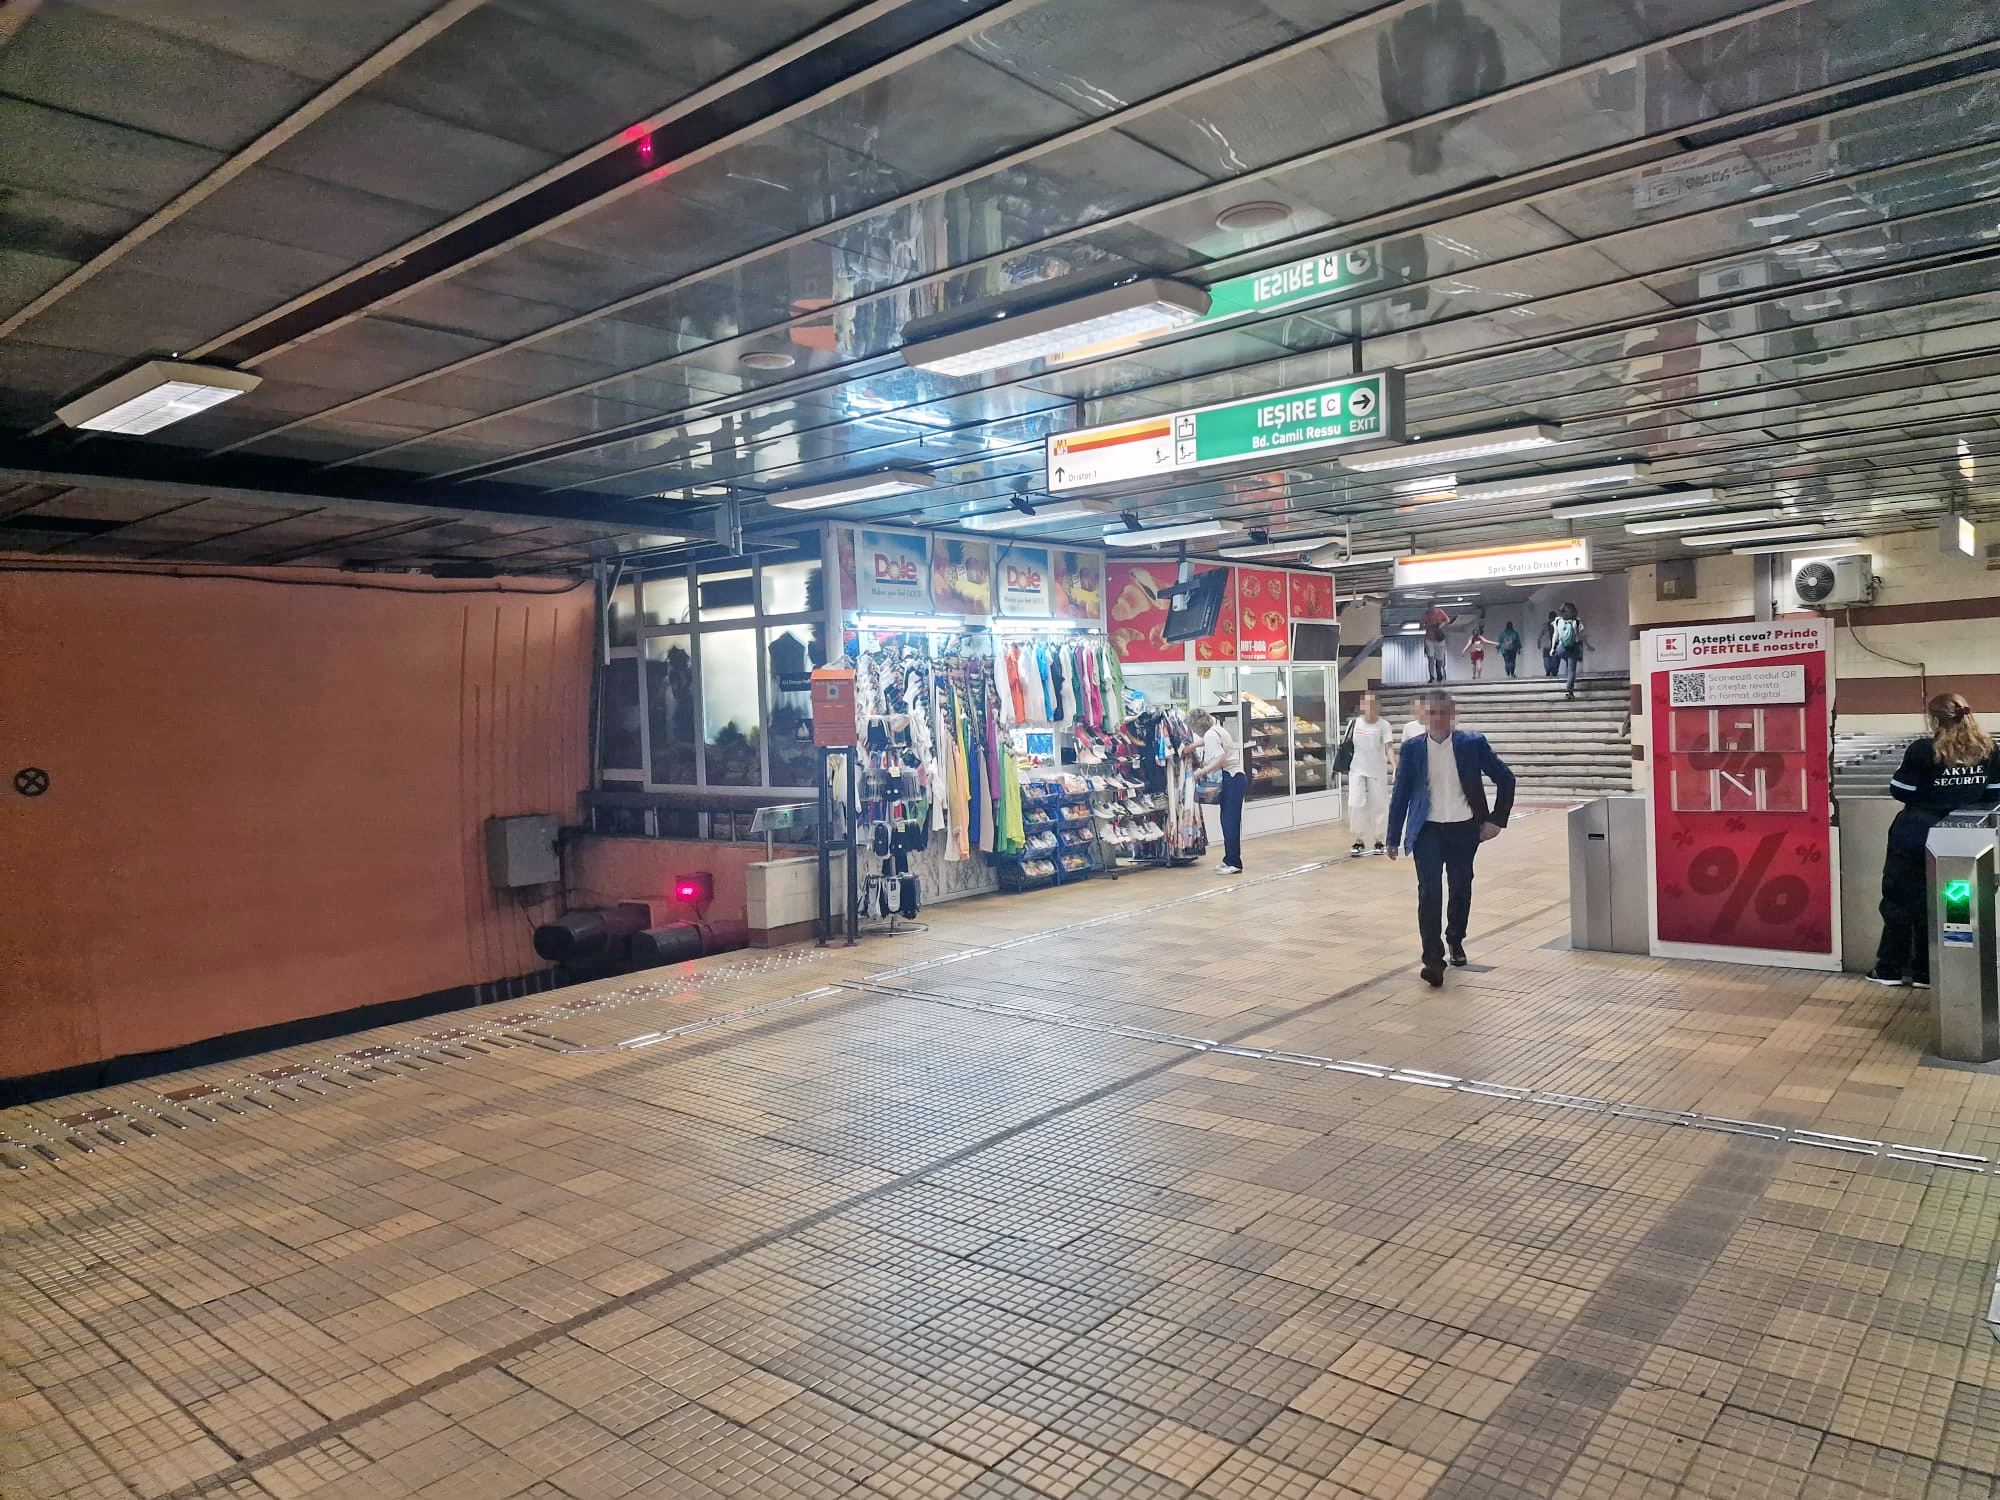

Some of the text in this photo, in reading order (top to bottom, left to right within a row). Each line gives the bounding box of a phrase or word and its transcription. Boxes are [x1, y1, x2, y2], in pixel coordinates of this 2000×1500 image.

[1257, 398, 1336, 429] IEȘIRE C
[1349, 416, 1377, 432] EXIT
[1252, 425, 1341, 448] Bd. Camil Ressu
[1068, 472, 1092, 482] Dristor
[875, 553, 918, 580] Dole
[1488, 566, 1506, 574] Spre
[1534, 560, 1562, 569] Dristor
[1007, 565, 1041, 588] Dole
[1692, 628, 1818, 645] Aștepți ceva? Prinde
[1692, 640, 1818, 655] OFERTELE noastre!
[1754, 672, 1779, 680] codul
[1781, 670, 1797, 679] QR
[1719, 691, 1749, 700] format
[1752, 690, 1781, 699] digital
[1942, 765, 1984, 776] AKYLE
[1933, 775, 1988, 787] SECURITY
